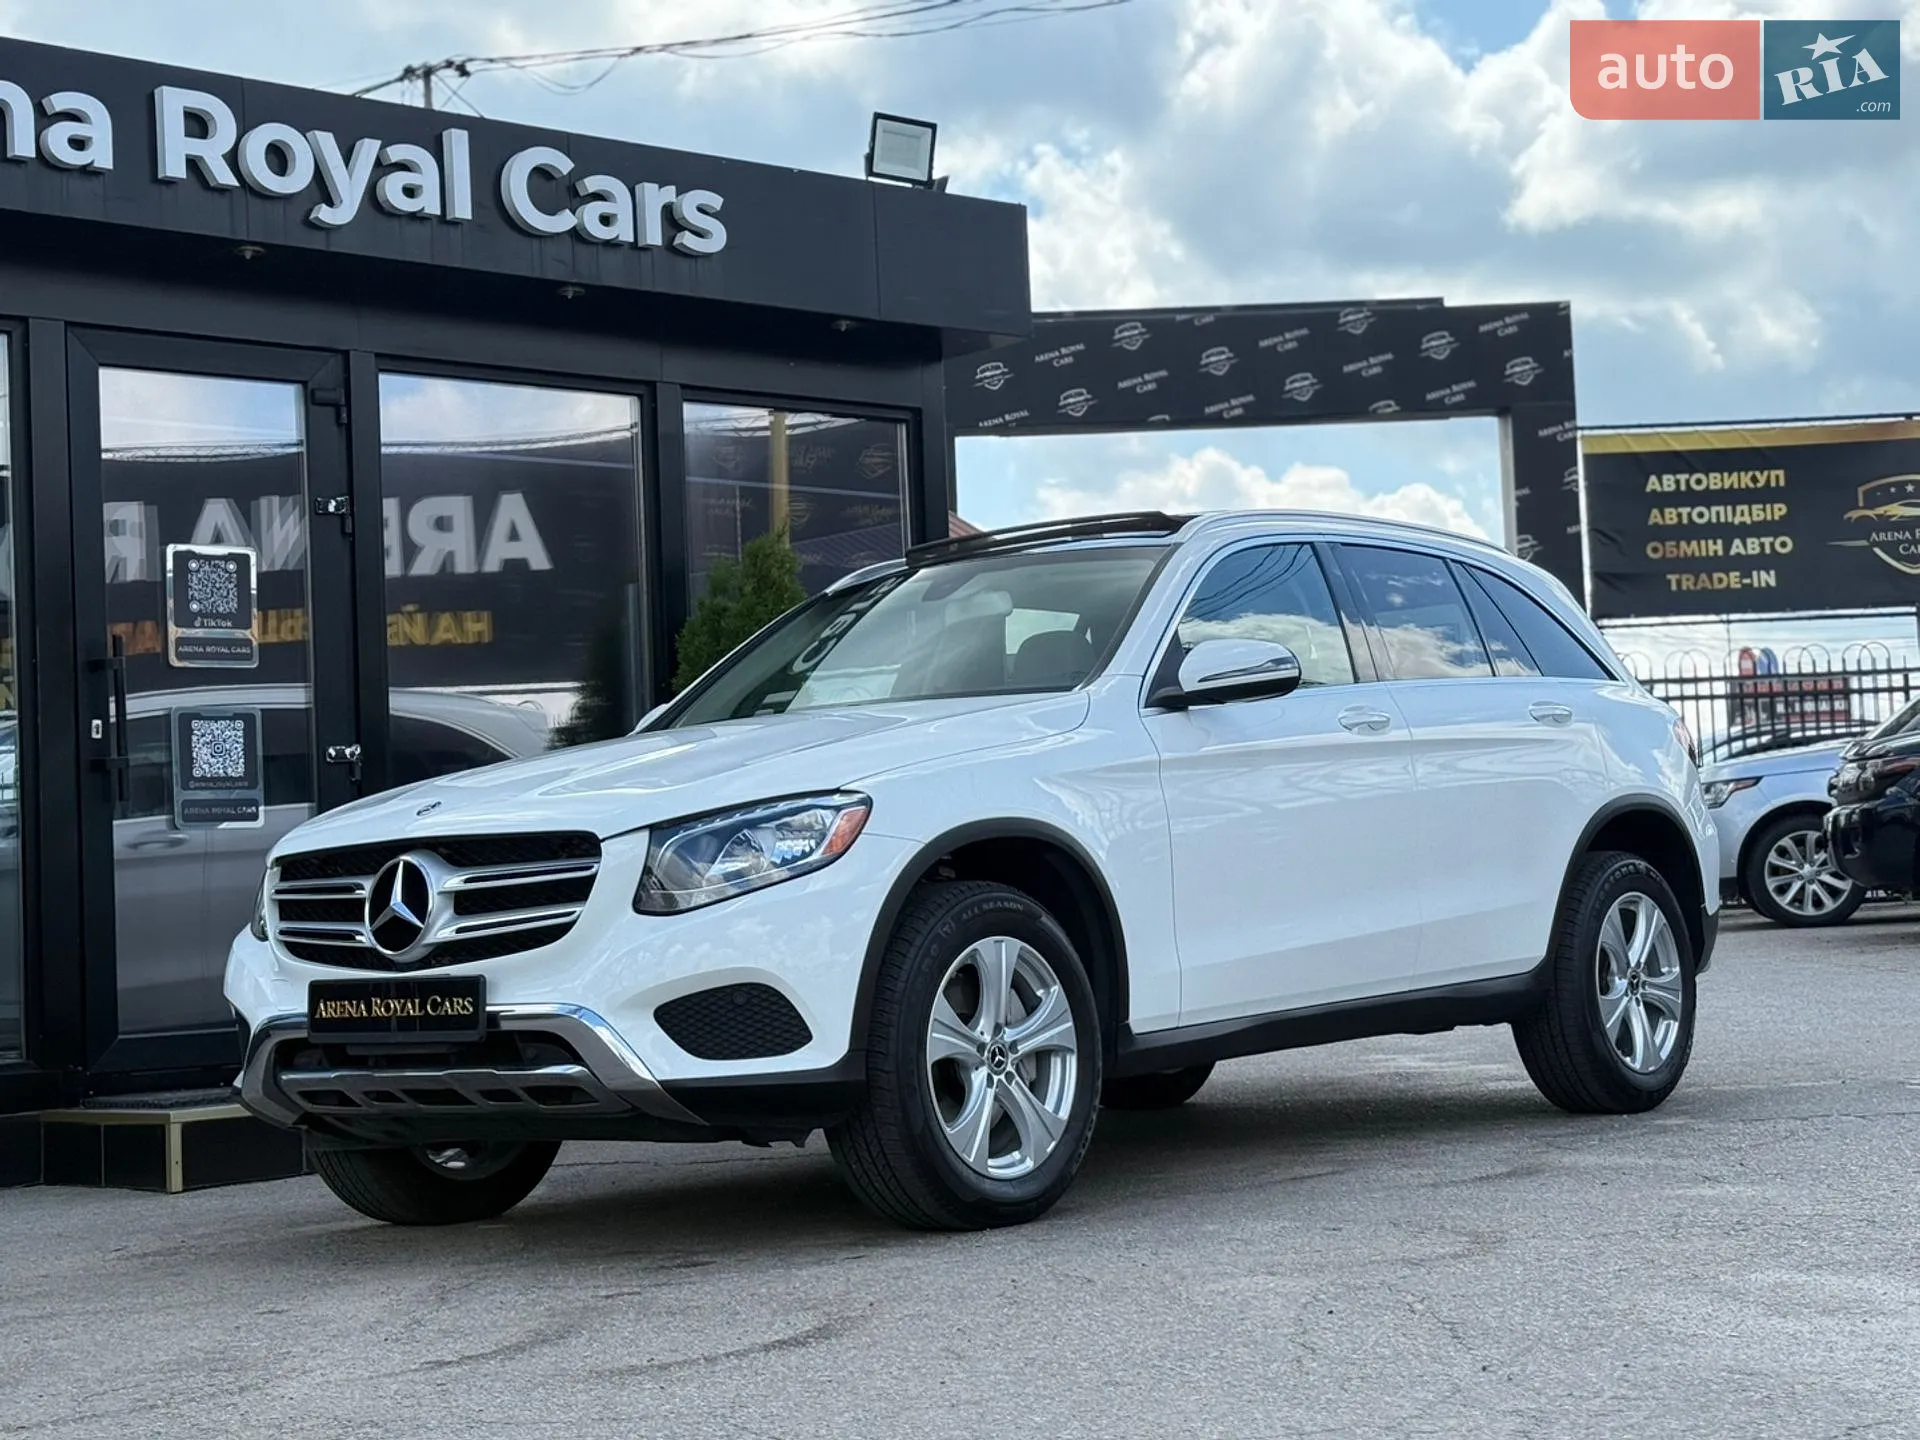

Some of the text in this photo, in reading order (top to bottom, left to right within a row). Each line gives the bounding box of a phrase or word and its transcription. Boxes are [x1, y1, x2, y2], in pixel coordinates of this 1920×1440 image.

[153, 84, 473, 230] Royal
[501, 146, 728, 256] Cars
[1645, 468, 1786, 492] АВТОВИКУП
[1648, 503, 1788, 526] АВТОПІДБІР
[1646, 535, 1794, 560] ОБМІН АВТО
[1870, 530, 1912, 543] ARENA
[1666, 569, 1777, 592] TRADE-IN
[314, 995, 474, 1019] ARENA ROYAL CARS
